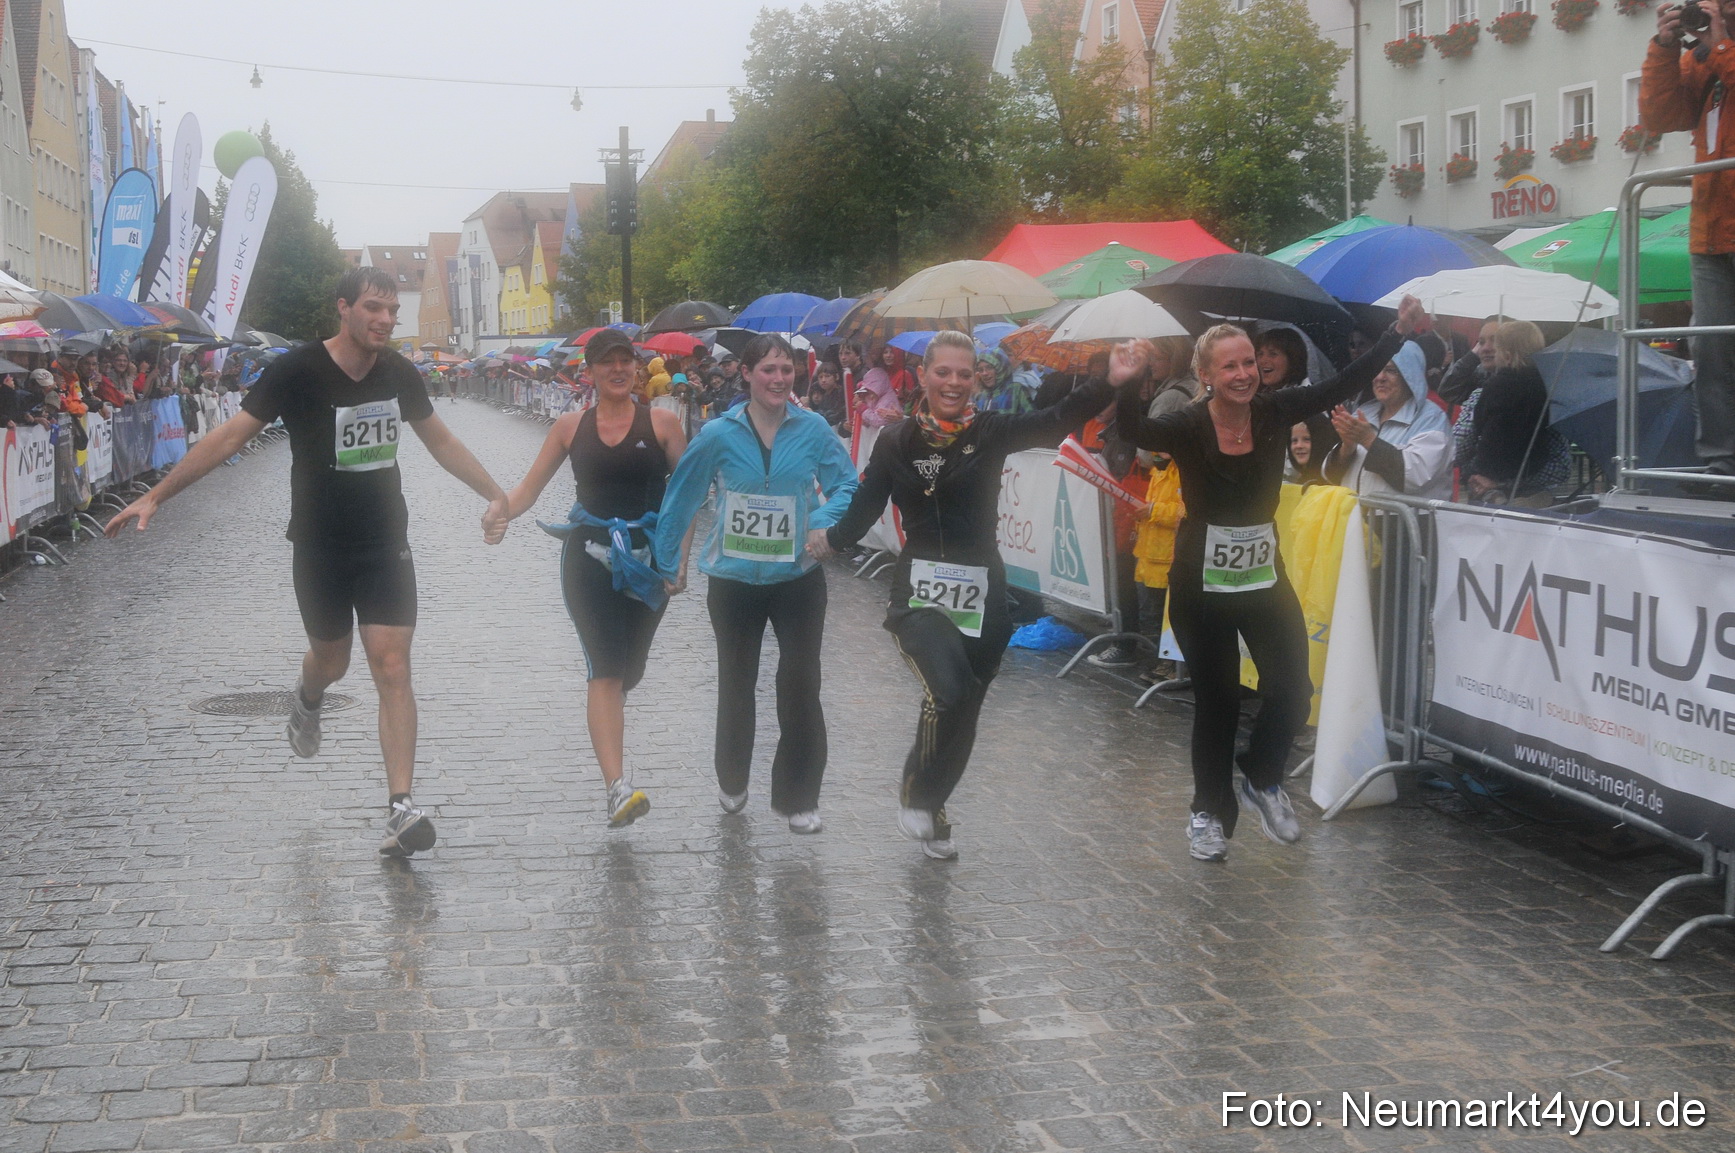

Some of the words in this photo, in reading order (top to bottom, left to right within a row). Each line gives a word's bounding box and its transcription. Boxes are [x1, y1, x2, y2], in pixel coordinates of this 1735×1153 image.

[1491, 184, 1556, 219] RENO
[179, 209, 187, 250] BKK
[176, 256, 184, 306] Audi
[224, 273, 240, 316] Audi
[234, 235, 249, 270] BKK
[342, 417, 398, 448] 5215
[360, 446, 384, 461] MAX
[731, 509, 790, 538] 5214
[736, 538, 781, 554] Martina
[1212, 541, 1271, 569] 5213
[916, 580, 980, 610] 5212
[1591, 672, 1671, 717] MEDIA
[1455, 674, 1535, 712] INTERNETLÖSUNGEN
[1545, 702, 1646, 748] SCHULUNGSZENTRUM
[1653, 738, 1705, 765] KONZEPT
[1708, 756, 1717, 773] &
[1514, 743, 1664, 815] www.nathus-media.de
